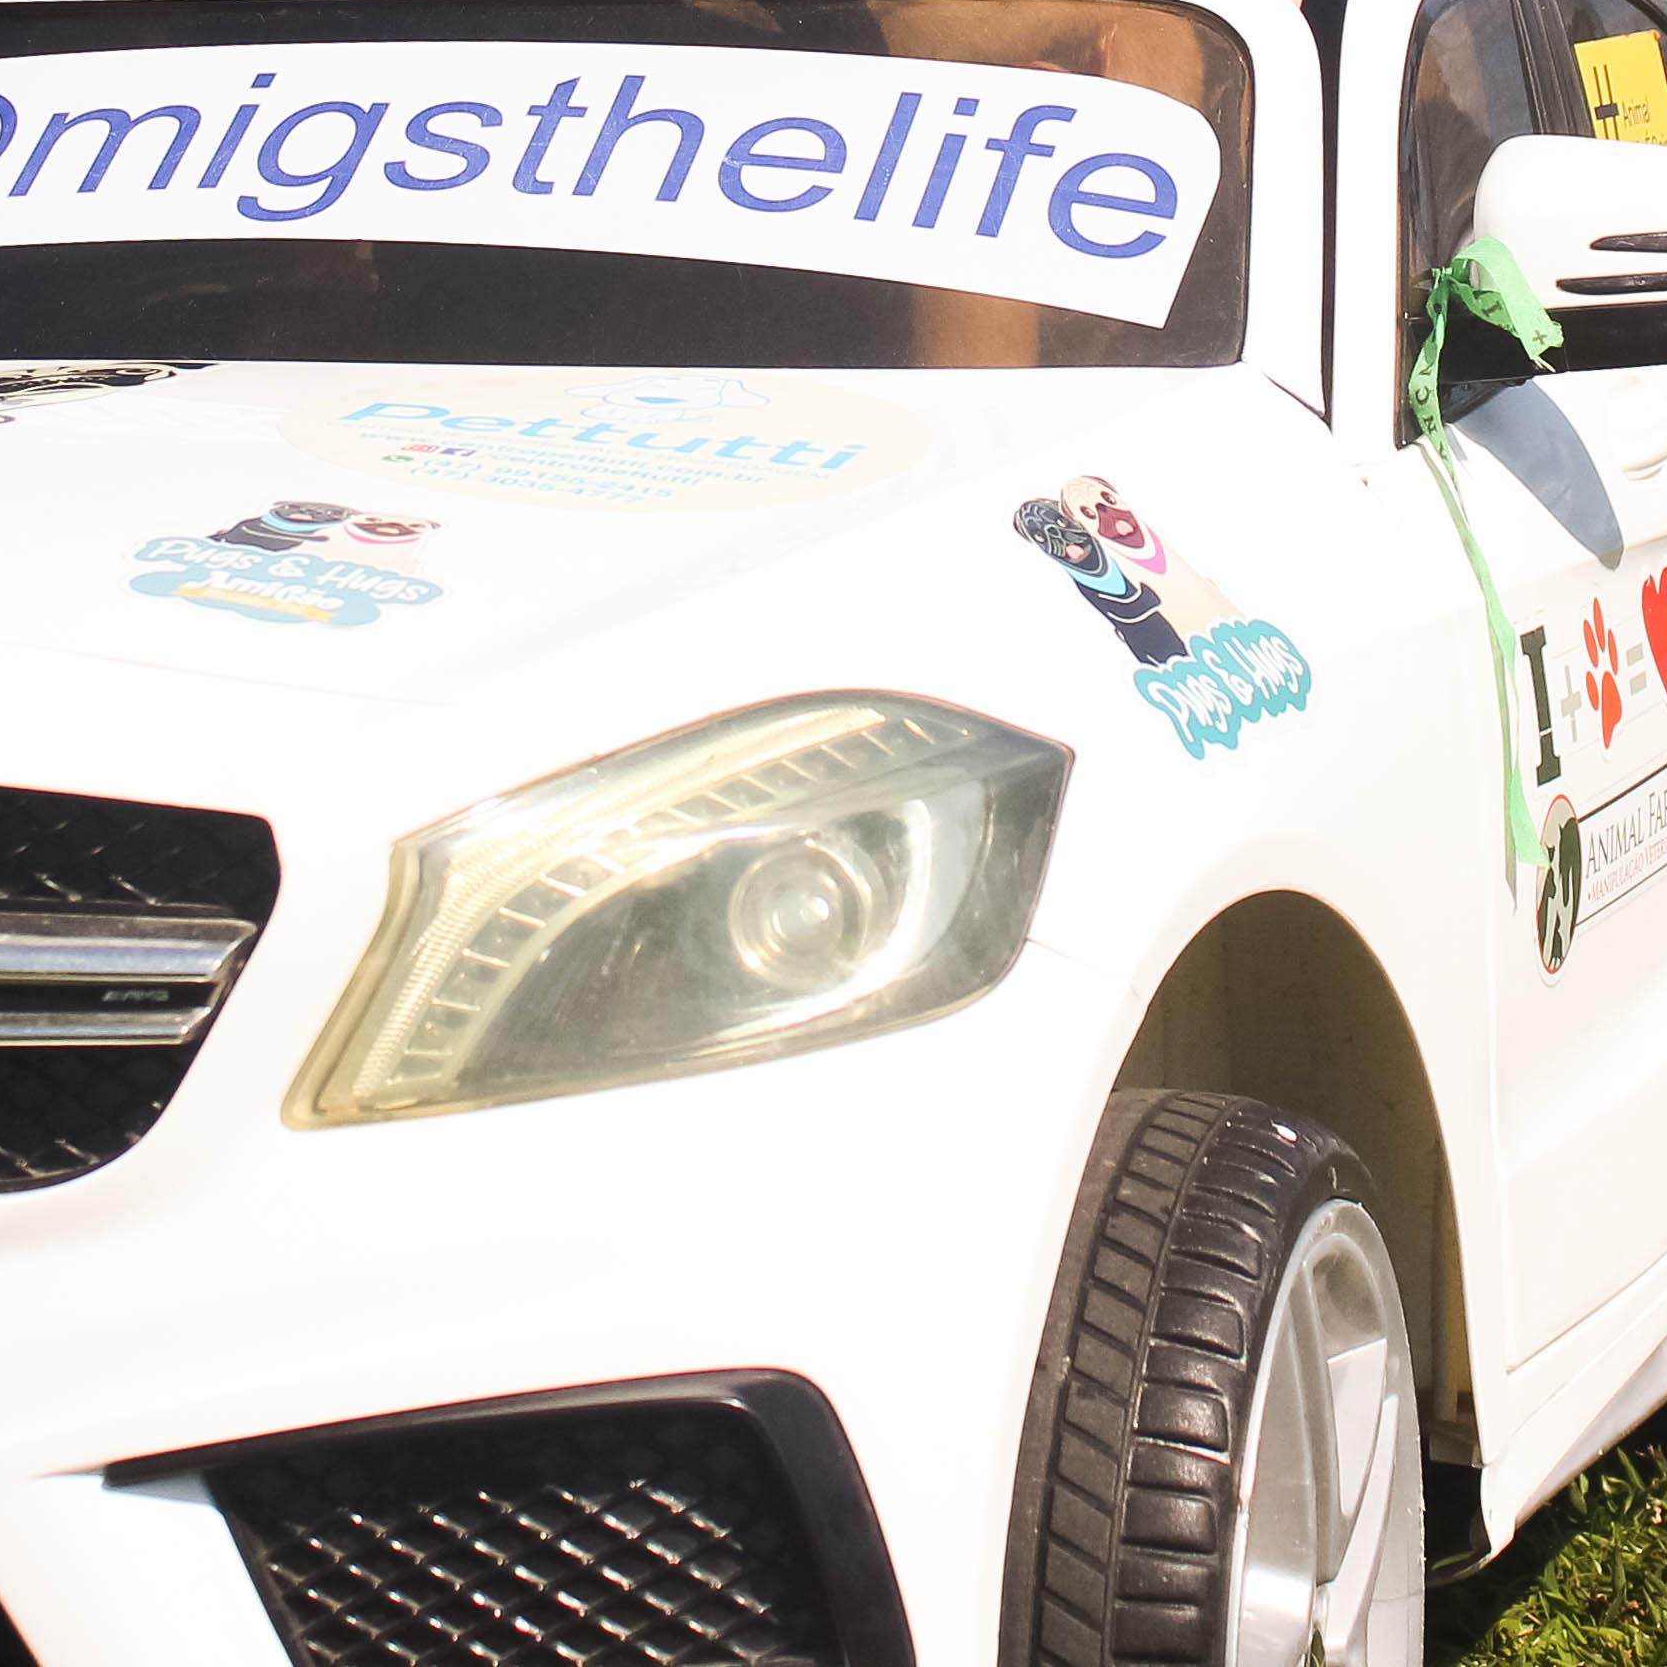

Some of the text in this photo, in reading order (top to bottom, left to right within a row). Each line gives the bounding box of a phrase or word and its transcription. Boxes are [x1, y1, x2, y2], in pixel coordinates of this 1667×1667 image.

[1621, 95, 1651, 129] Animal
[341, 402, 867, 470] Pettutti
[147, 540, 430, 602] Pugs & Hugs
[1146, 634, 1305, 744] Pugs & Hugs
[1585, 806, 1645, 880] ANIMAL
